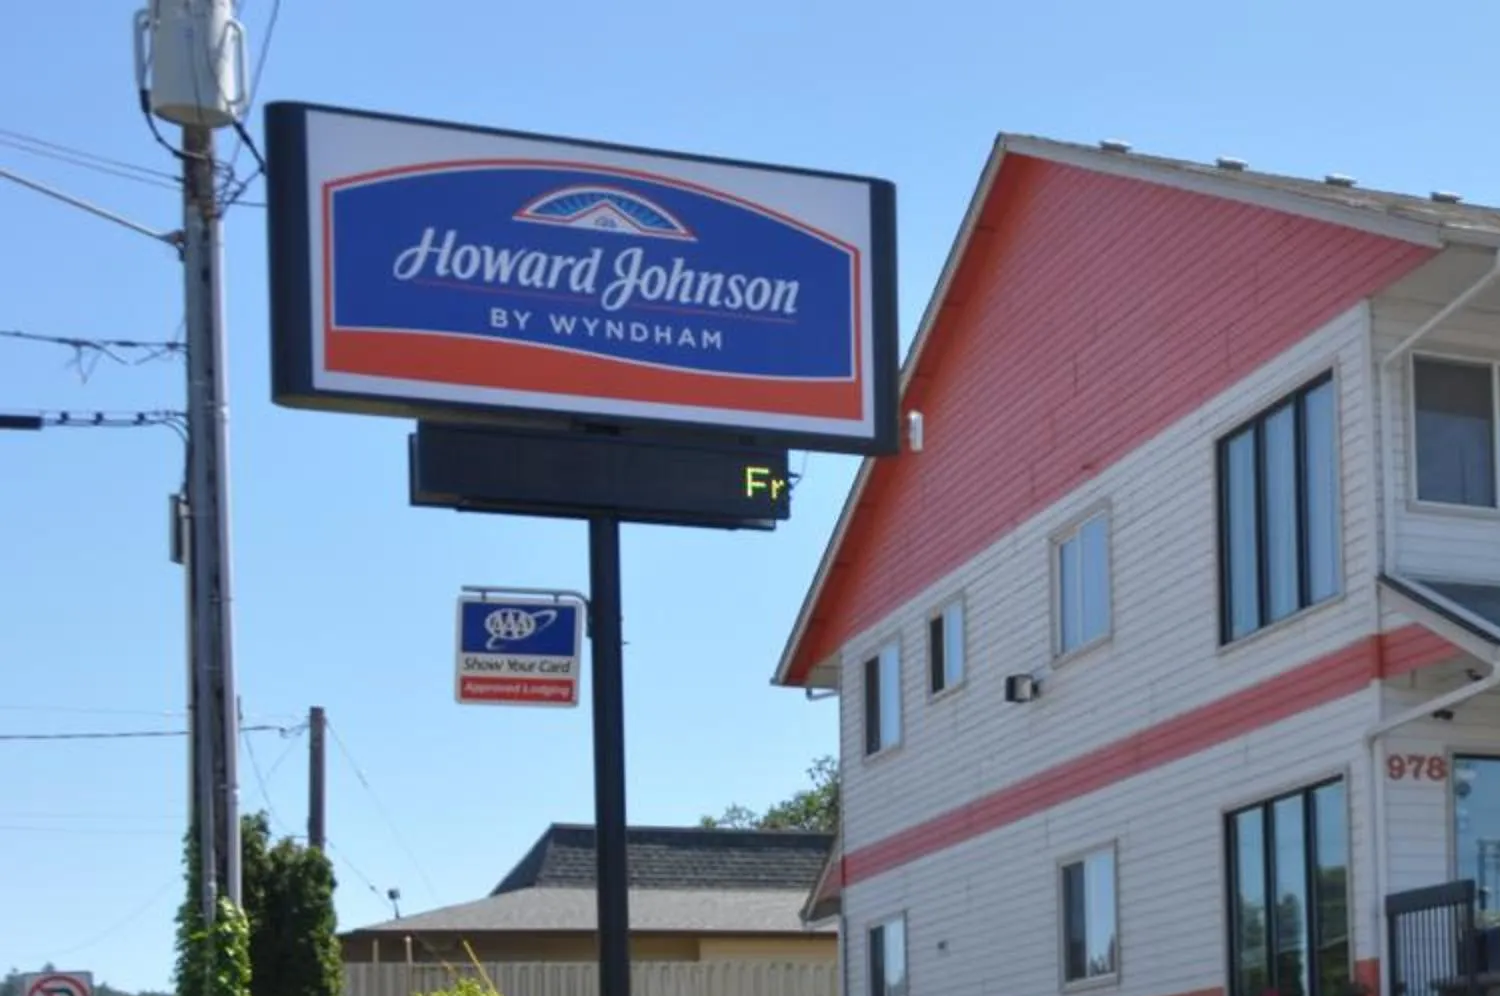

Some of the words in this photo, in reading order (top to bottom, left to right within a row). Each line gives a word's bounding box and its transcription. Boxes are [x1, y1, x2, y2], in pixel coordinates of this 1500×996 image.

[393, 227, 603, 294] Howard
[601, 247, 799, 314] Johnson
[490, 307, 532, 331] BY
[549, 313, 722, 350] WYNDHAM
[746, 466, 785, 500] Fr
[463, 657, 503, 671] Show
[506, 658, 536, 673] Your
[538, 660, 571, 673] Card
[1387, 754, 1447, 781] 978
